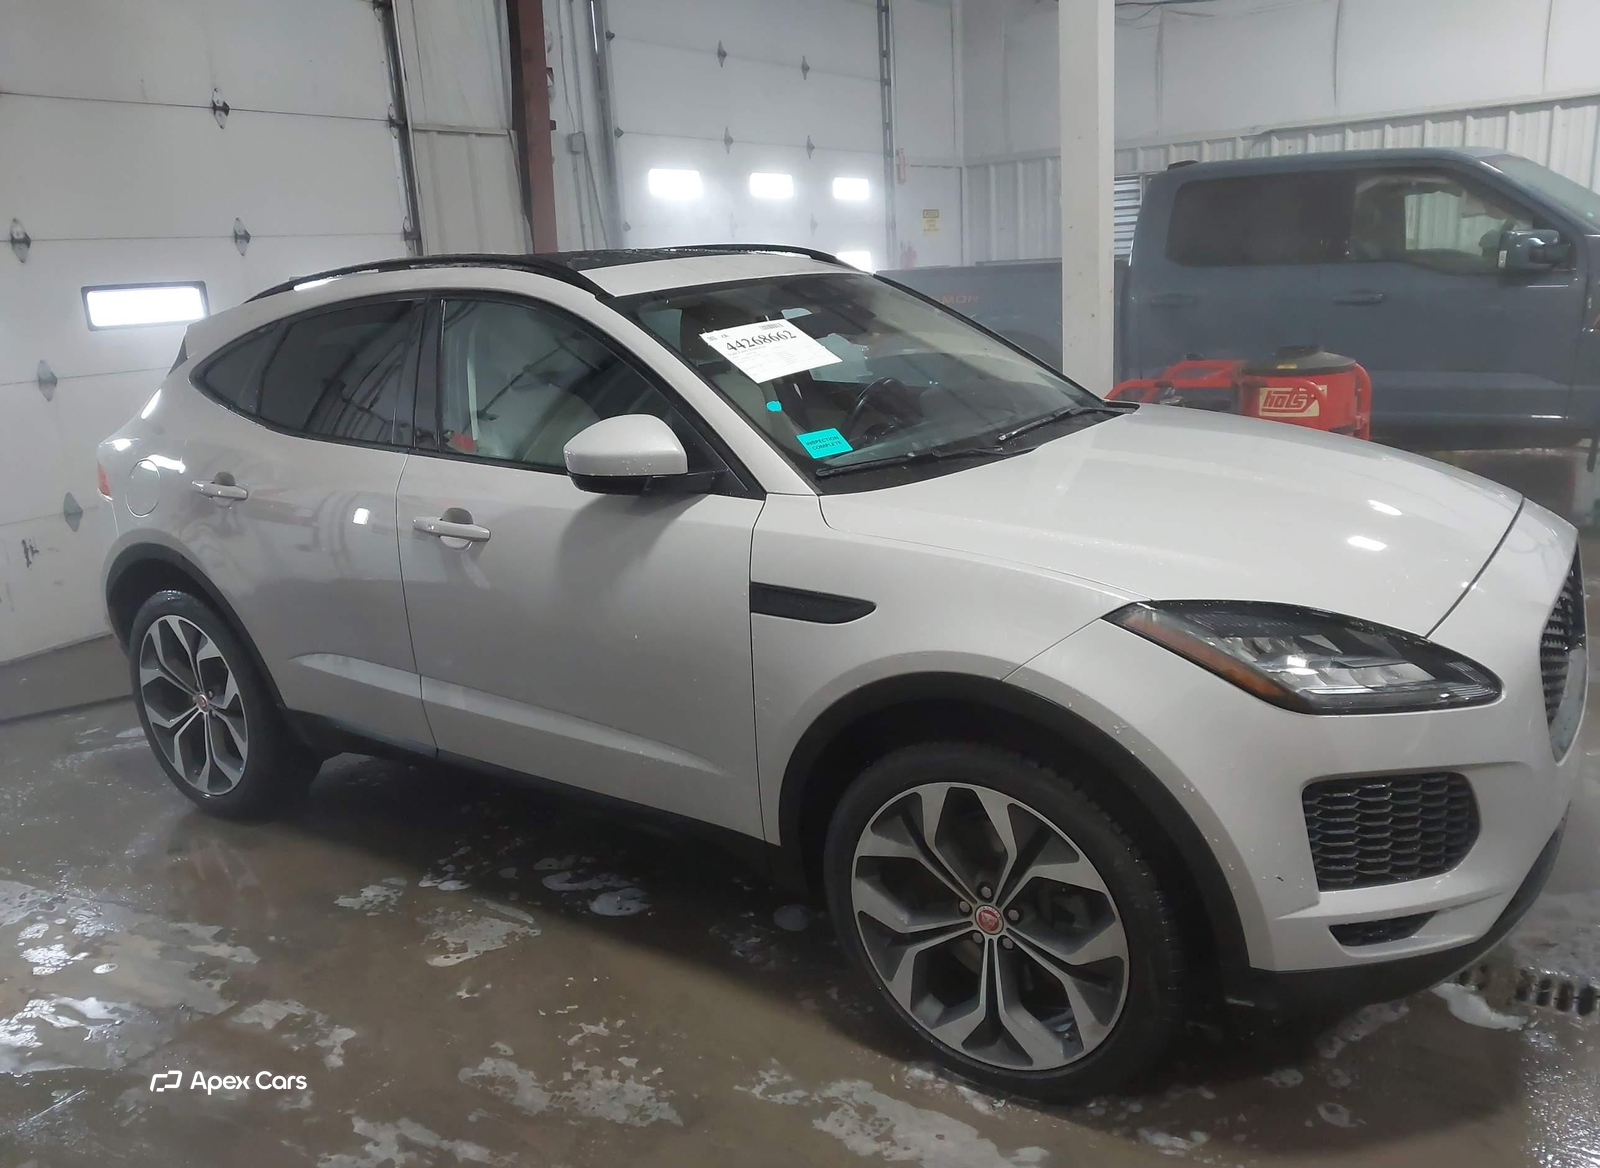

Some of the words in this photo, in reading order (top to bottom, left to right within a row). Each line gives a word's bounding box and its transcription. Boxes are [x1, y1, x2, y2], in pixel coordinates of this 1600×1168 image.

[725, 330, 797, 352] 44268662
[804, 435, 840, 446] INSPECTION
[811, 441, 841, 451] COMPLETE
